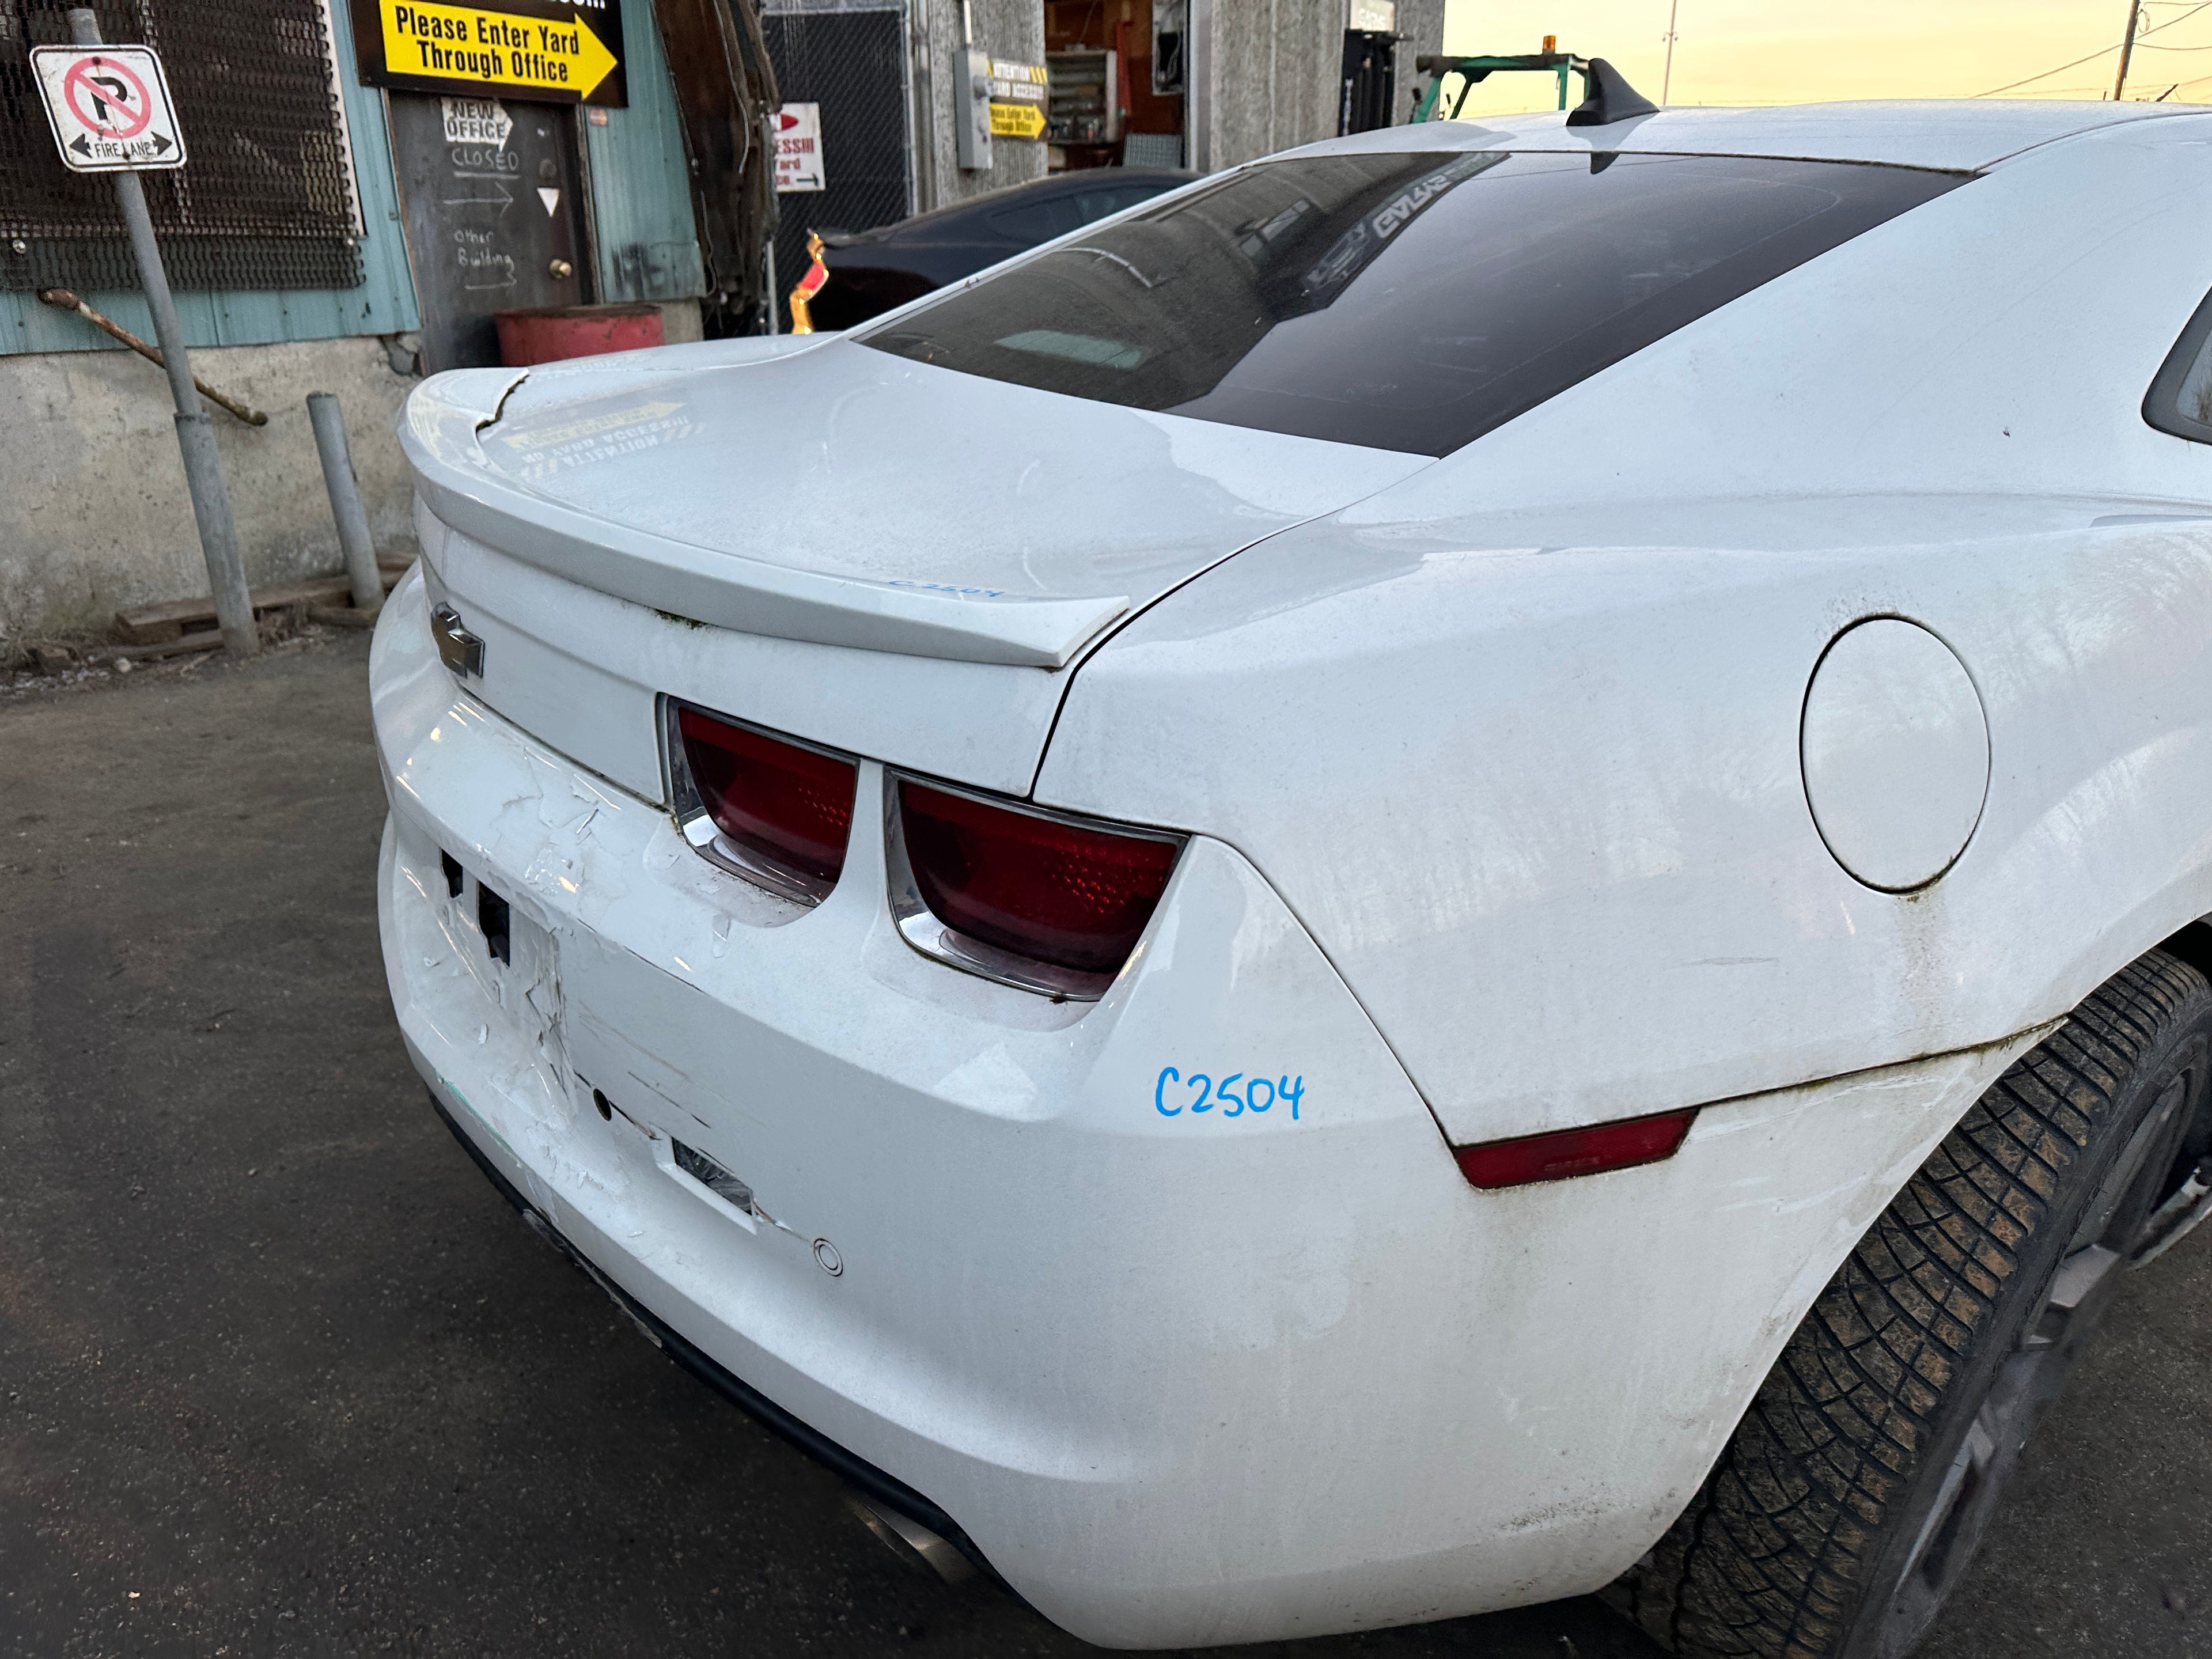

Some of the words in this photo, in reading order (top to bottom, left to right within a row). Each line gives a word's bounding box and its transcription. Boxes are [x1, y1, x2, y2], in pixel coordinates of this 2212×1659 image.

[395, 5, 467, 41] Please
[476, 16, 529, 49] Enter
[539, 25, 579, 55] Yard
[416, 39, 502, 78] Through
[512, 50, 568, 82] Office
[452, 101, 494, 119] NEW
[446, 116, 506, 139] OFFICE
[94, 142, 121, 158] FIRE
[452, 147, 518, 171] CLOSED
[1155, 1066, 1305, 1120] C2504
